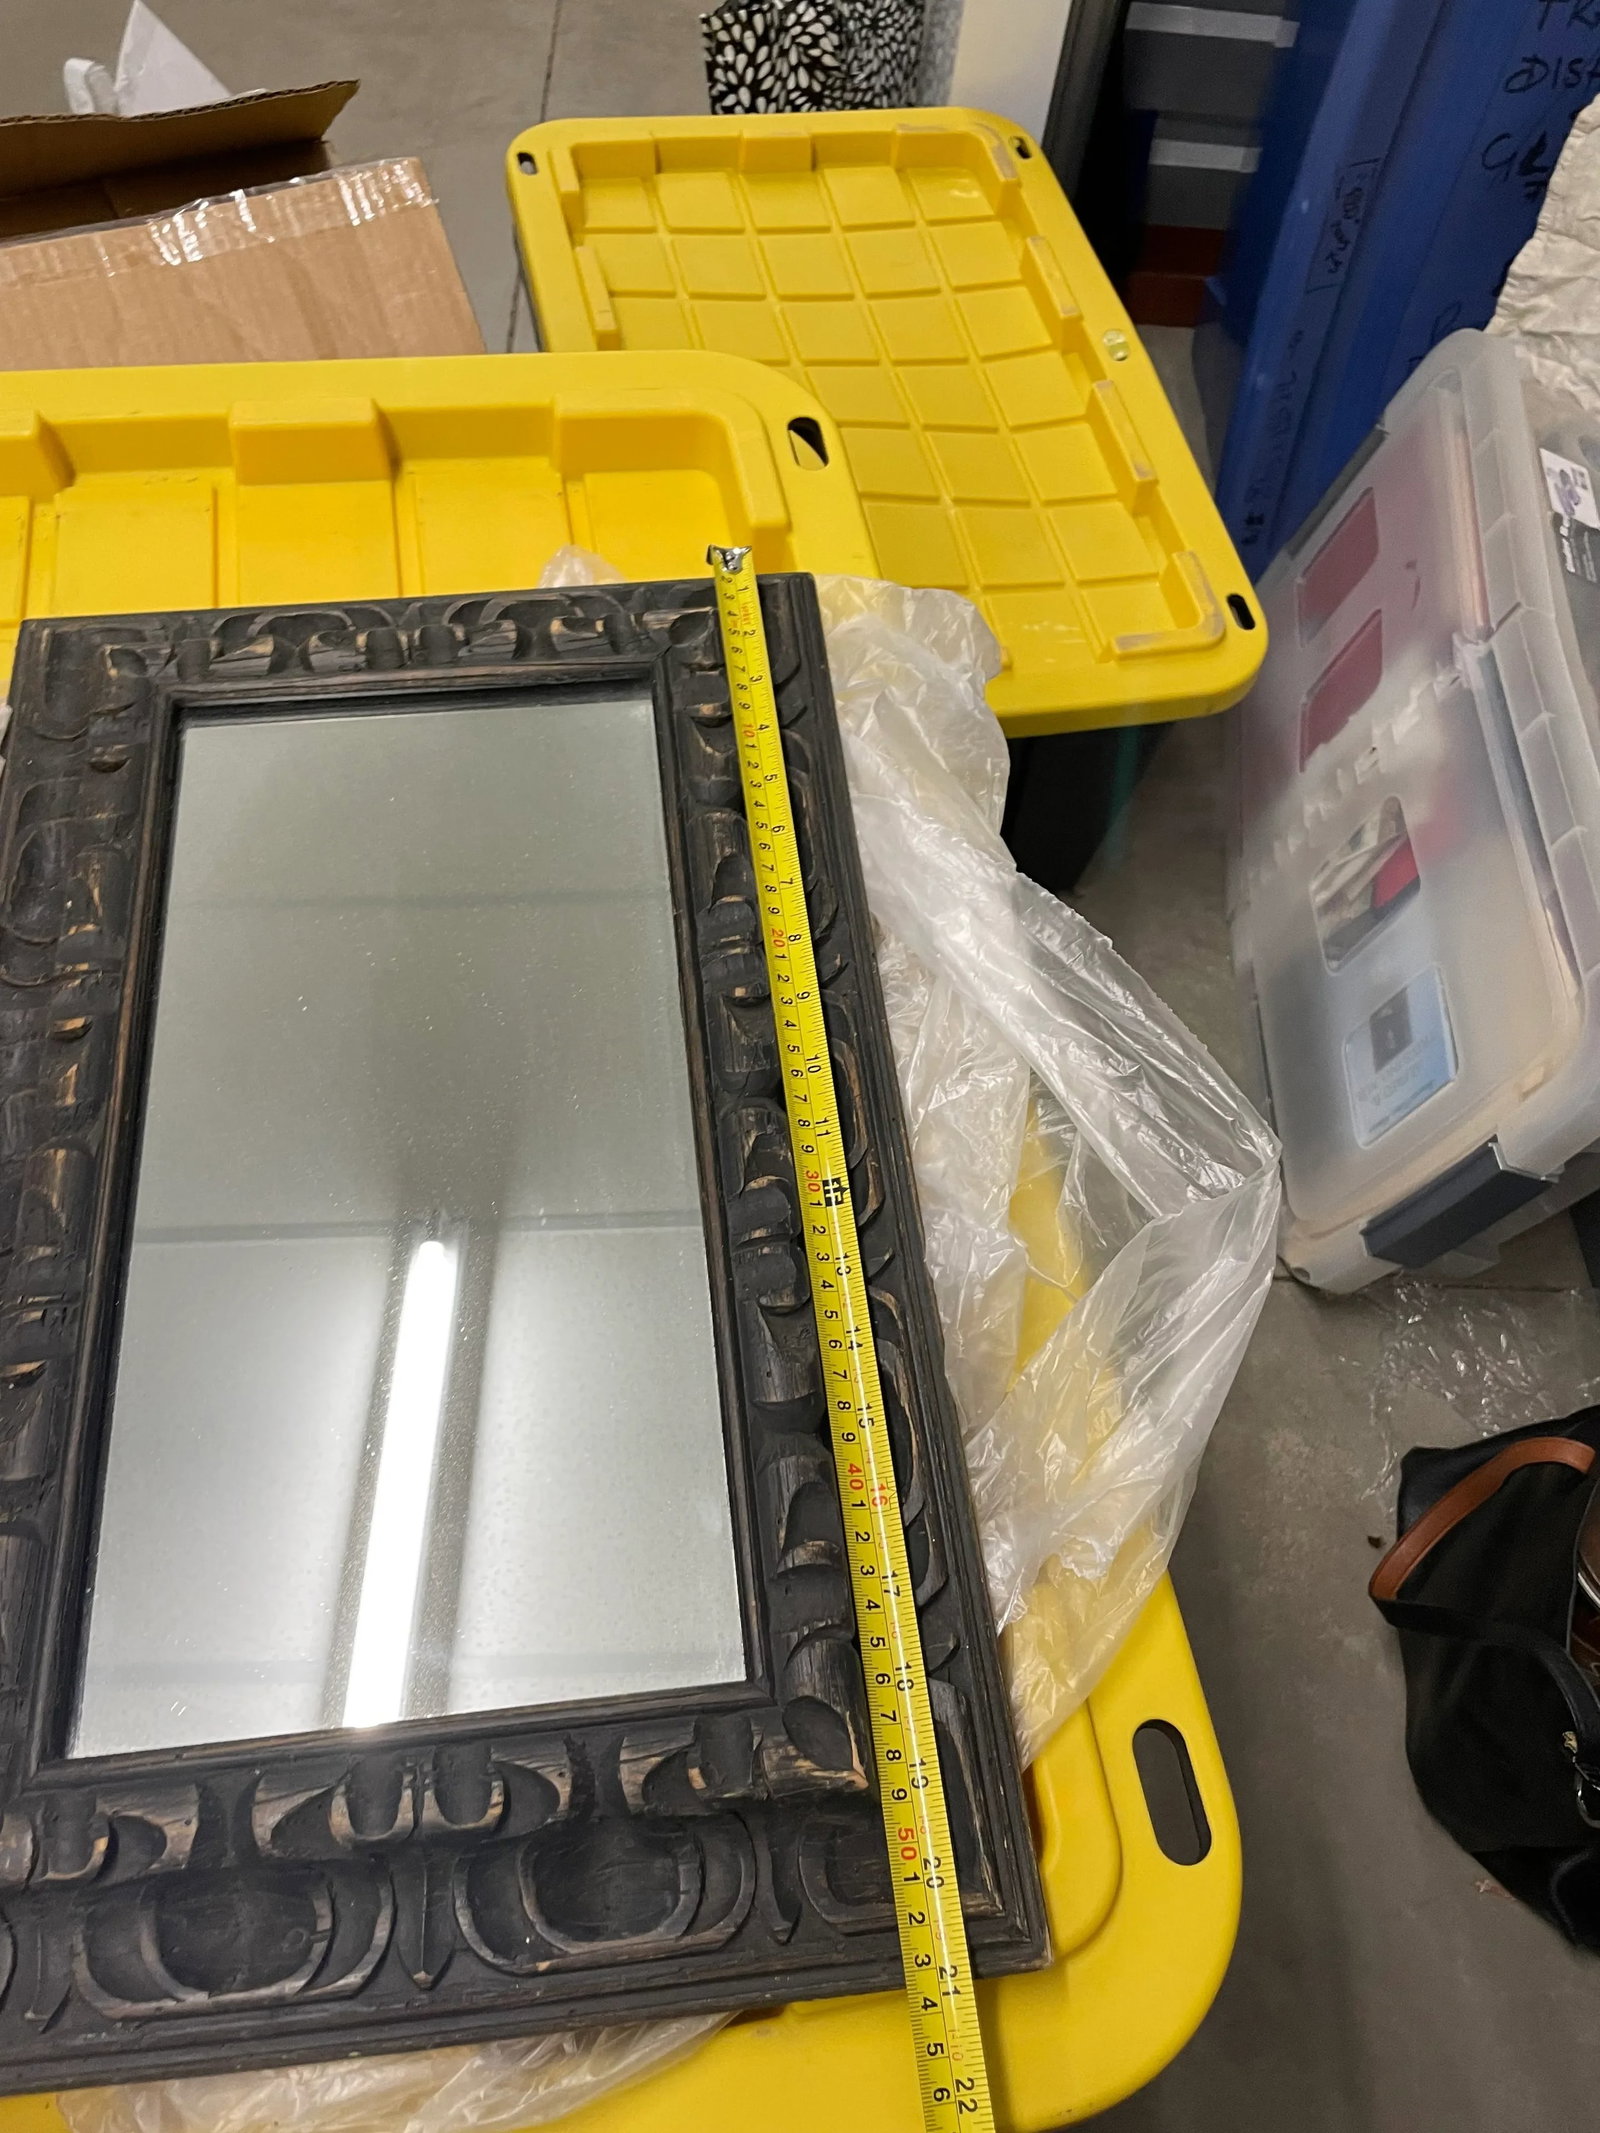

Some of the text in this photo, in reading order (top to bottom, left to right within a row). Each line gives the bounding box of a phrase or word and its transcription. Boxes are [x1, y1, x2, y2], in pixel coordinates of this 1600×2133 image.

[730, 646, 743, 654] 6
[733, 665, 746, 673] 7
[749, 674, 764, 683] 3
[736, 683, 749, 691] 8
[738, 701, 751, 710] 9
[742, 723, 755, 738] 10
[757, 723, 770, 731] 4
[746, 760, 760, 769] 2
[763, 773, 778, 782] 5
[749, 779, 763, 788] 3
[753, 800, 766, 808] 4
[755, 821, 769, 830] 5
[772, 824, 786, 834] 6
[758, 842, 771, 851] 6
[761, 863, 775, 872] 7
[780, 877, 794, 885] 7
[764, 884, 777, 893] 8
[767, 906, 781, 915] 9
[771, 927, 786, 948] 20
[788, 933, 802, 942] 8
[776, 972, 790, 983] 2
[780, 996, 794, 1005] 3
[796, 990, 811, 1000] 9
[783, 1019, 797, 1028] 4
[787, 1043, 801, 1053] 5
[805, 1053, 822, 1074] 10
[790, 1069, 804, 1078] 6
[794, 1094, 808, 1103] 7
[797, 1118, 811, 1128] 8
[815, 1116, 832, 1137] 11
[801, 1144, 815, 1154] 9
[805, 1170, 821, 1193] 30
[812, 1224, 827, 1235] 2
[816, 1251, 831, 1262] 3
[835, 1251, 852, 1277] 13
[820, 1279, 835, 1290] 4
[824, 1309, 839, 1320] 5
[845, 1325, 864, 1351] 14
[828, 1339, 843, 1350] 6
[832, 1369, 849, 1380] 7
[836, 1400, 852, 1411] 8
[856, 1402, 875, 1429] 15
[841, 1431, 857, 1443] 9
[847, 1463, 864, 1491] 40
[870, 1483, 889, 1507] 16
[854, 1530, 871, 1543] 2
[860, 1564, 876, 1576] 3
[881, 1570, 901, 1597] 17
[865, 1598, 881, 1611] 4
[869, 1636, 886, 1648] 5
[875, 1672, 891, 1685] 6
[894, 1661, 915, 1692] 18
[880, 1709, 898, 1723] 7
[885, 1749, 902, 1762] 8
[908, 1757, 930, 1790] 19
[891, 1787, 908, 1801] 9
[897, 1827, 918, 1861] 50
[922, 1856, 945, 1889] 20
[908, 1911, 926, 1926] 2
[914, 1953, 931, 1968] 3
[938, 1965, 961, 1997] 21
[920, 1996, 938, 2012] 4
[926, 2042, 945, 2057] 5
[933, 2086, 951, 2102] 6
[954, 2076, 979, 2115] 22
